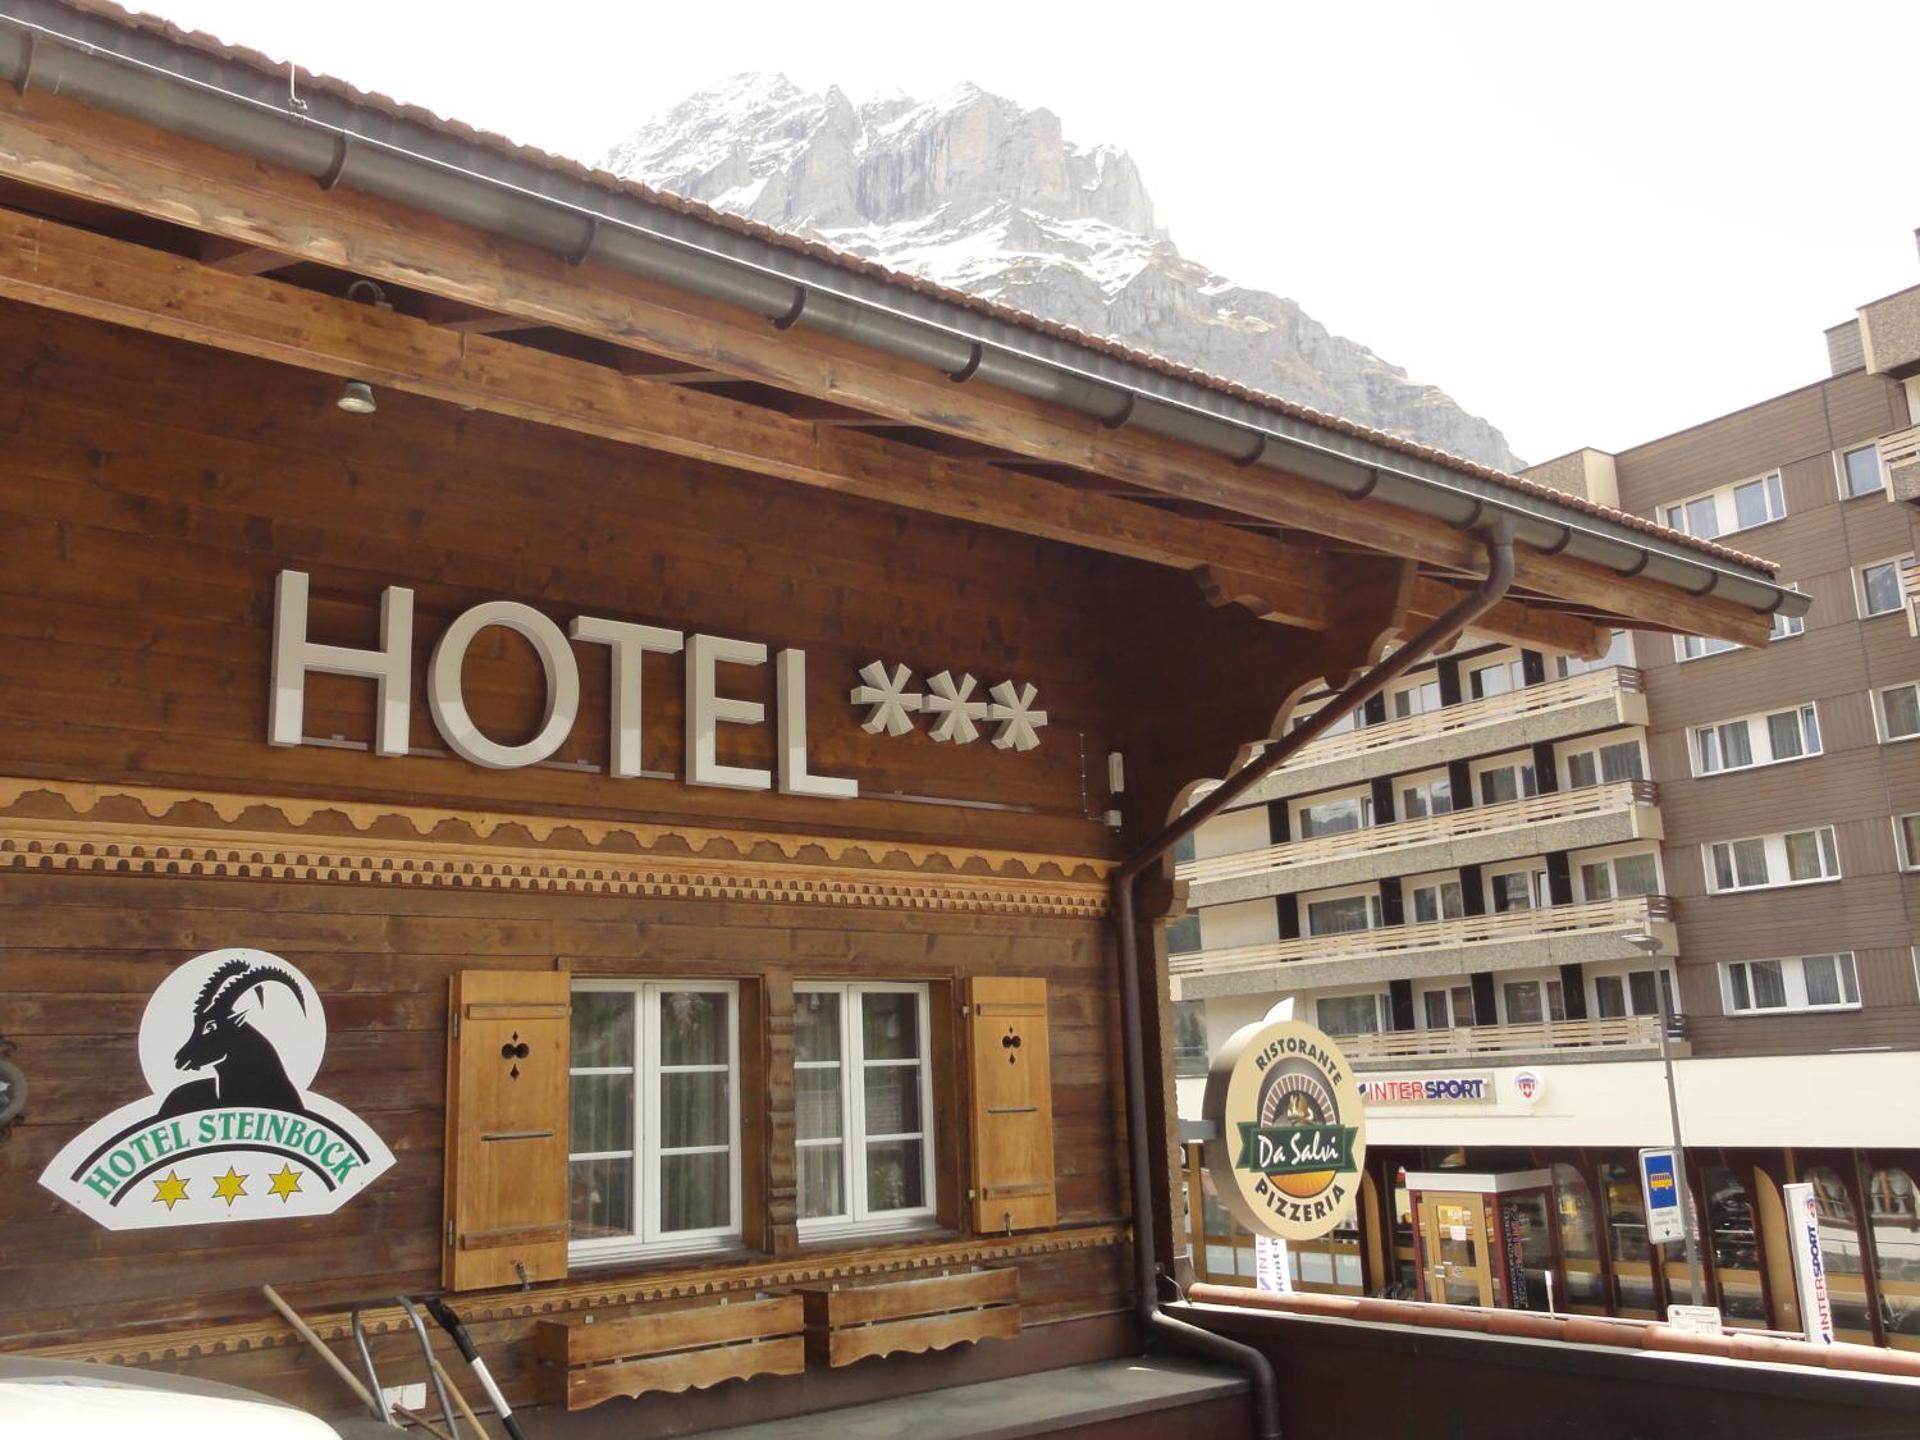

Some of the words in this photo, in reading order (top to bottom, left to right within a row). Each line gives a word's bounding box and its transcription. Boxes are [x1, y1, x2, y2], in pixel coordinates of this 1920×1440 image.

[268, 569, 858, 799] HOTEL
[1254, 1037, 1342, 1088] RISTORANTE
[1369, 1079, 1483, 1101] INTERSPORT
[83, 1121, 191, 1200] HOTEL
[198, 1111, 363, 1185] STEINBOCK
[1257, 1134, 1286, 1168] Da
[1290, 1130, 1339, 1165] Salvi
[1254, 1178, 1346, 1222] PIZZERIA
[1807, 1225, 1830, 1331] INTERSPORT
